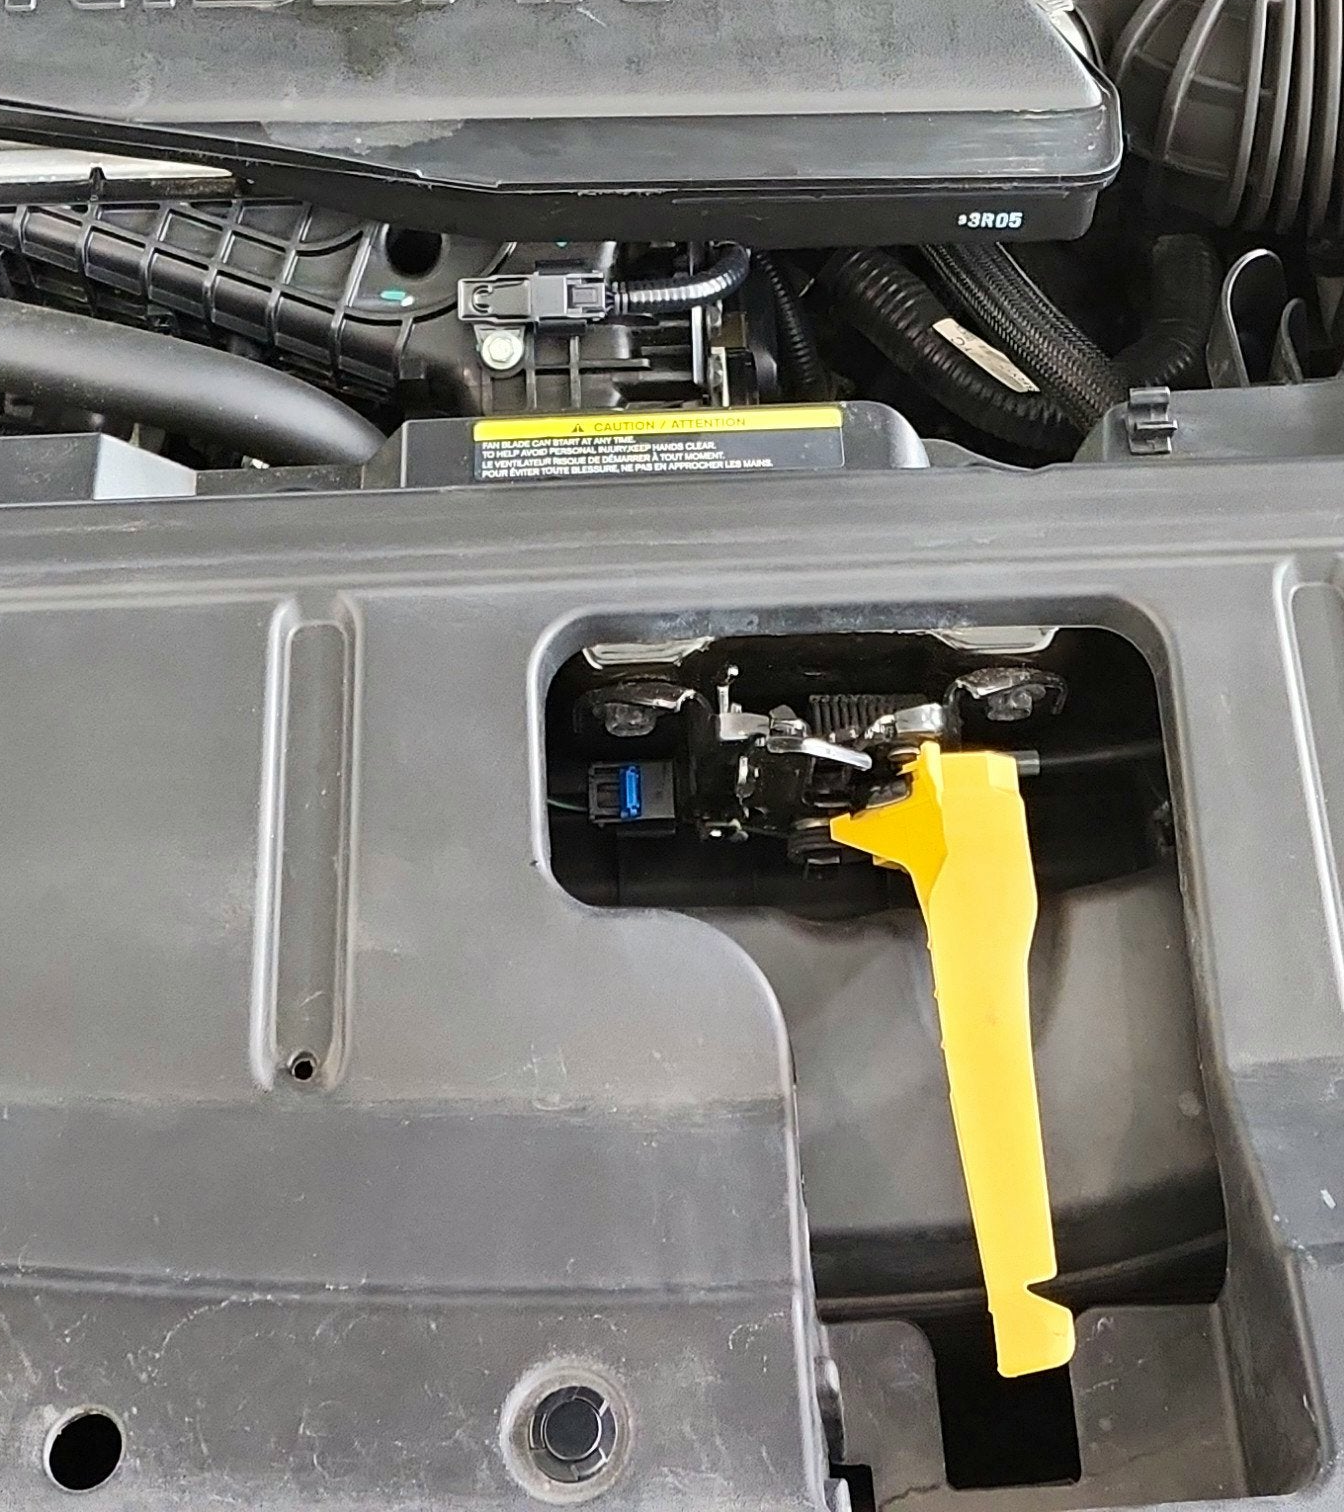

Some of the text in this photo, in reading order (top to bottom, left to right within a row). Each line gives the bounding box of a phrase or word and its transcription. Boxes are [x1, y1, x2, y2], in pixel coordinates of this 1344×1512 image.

[594, 420, 655, 432] CAUTION
[671, 417, 746, 429] ATTENTION
[482, 436, 636, 449] FAN BLADE CAN START AT ANY TIME.
[482, 450, 494, 458] TO
[496, 449, 520, 458] HELP
[520, 448, 548, 456] AVOID
[549, 446, 596, 456] PERSONAL
[652, 443, 684, 452] HANDS
[685, 441, 716, 450] CLEAR.
[482, 451, 726, 469] LE VENTILATEUR RISQUE DE DÉMARRER À TOUT MOMENT.
[482, 459, 774, 478] POUR ÉVITER TOUTE BLESSURE, NE PAS EN APPROCHER LES MAINS.
